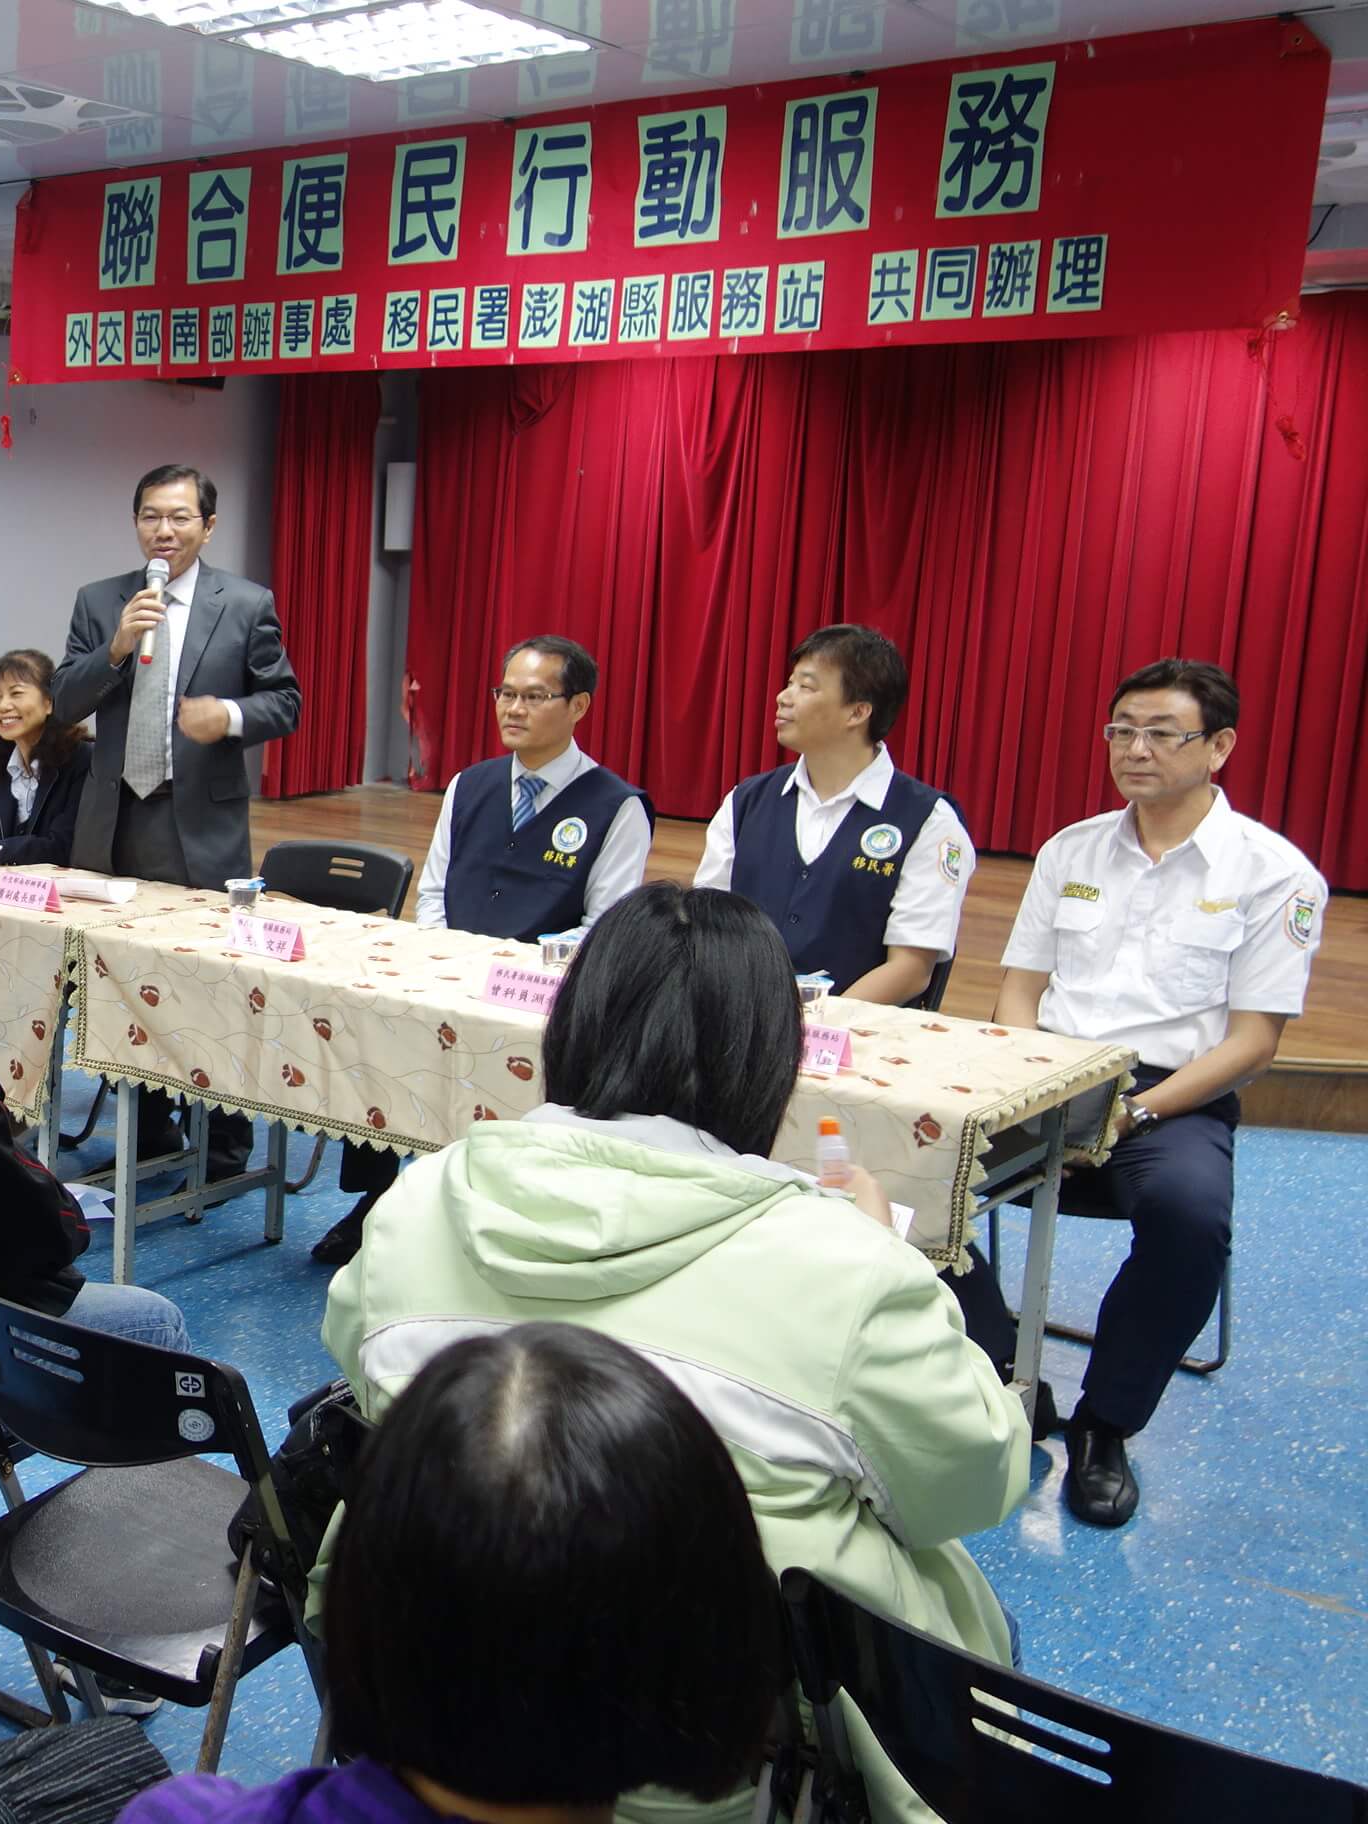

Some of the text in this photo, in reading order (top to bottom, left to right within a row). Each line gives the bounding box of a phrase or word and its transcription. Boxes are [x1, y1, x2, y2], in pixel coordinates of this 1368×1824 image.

[100, 72, 1047, 286] 聯合便民行動服務
[67, 235, 1102, 364] 外交部南部辦事處 移民署澎湖縣服務站 共同辦理
[543, 850, 577, 868] 移民署
[852, 856, 895, 877] 移民署
